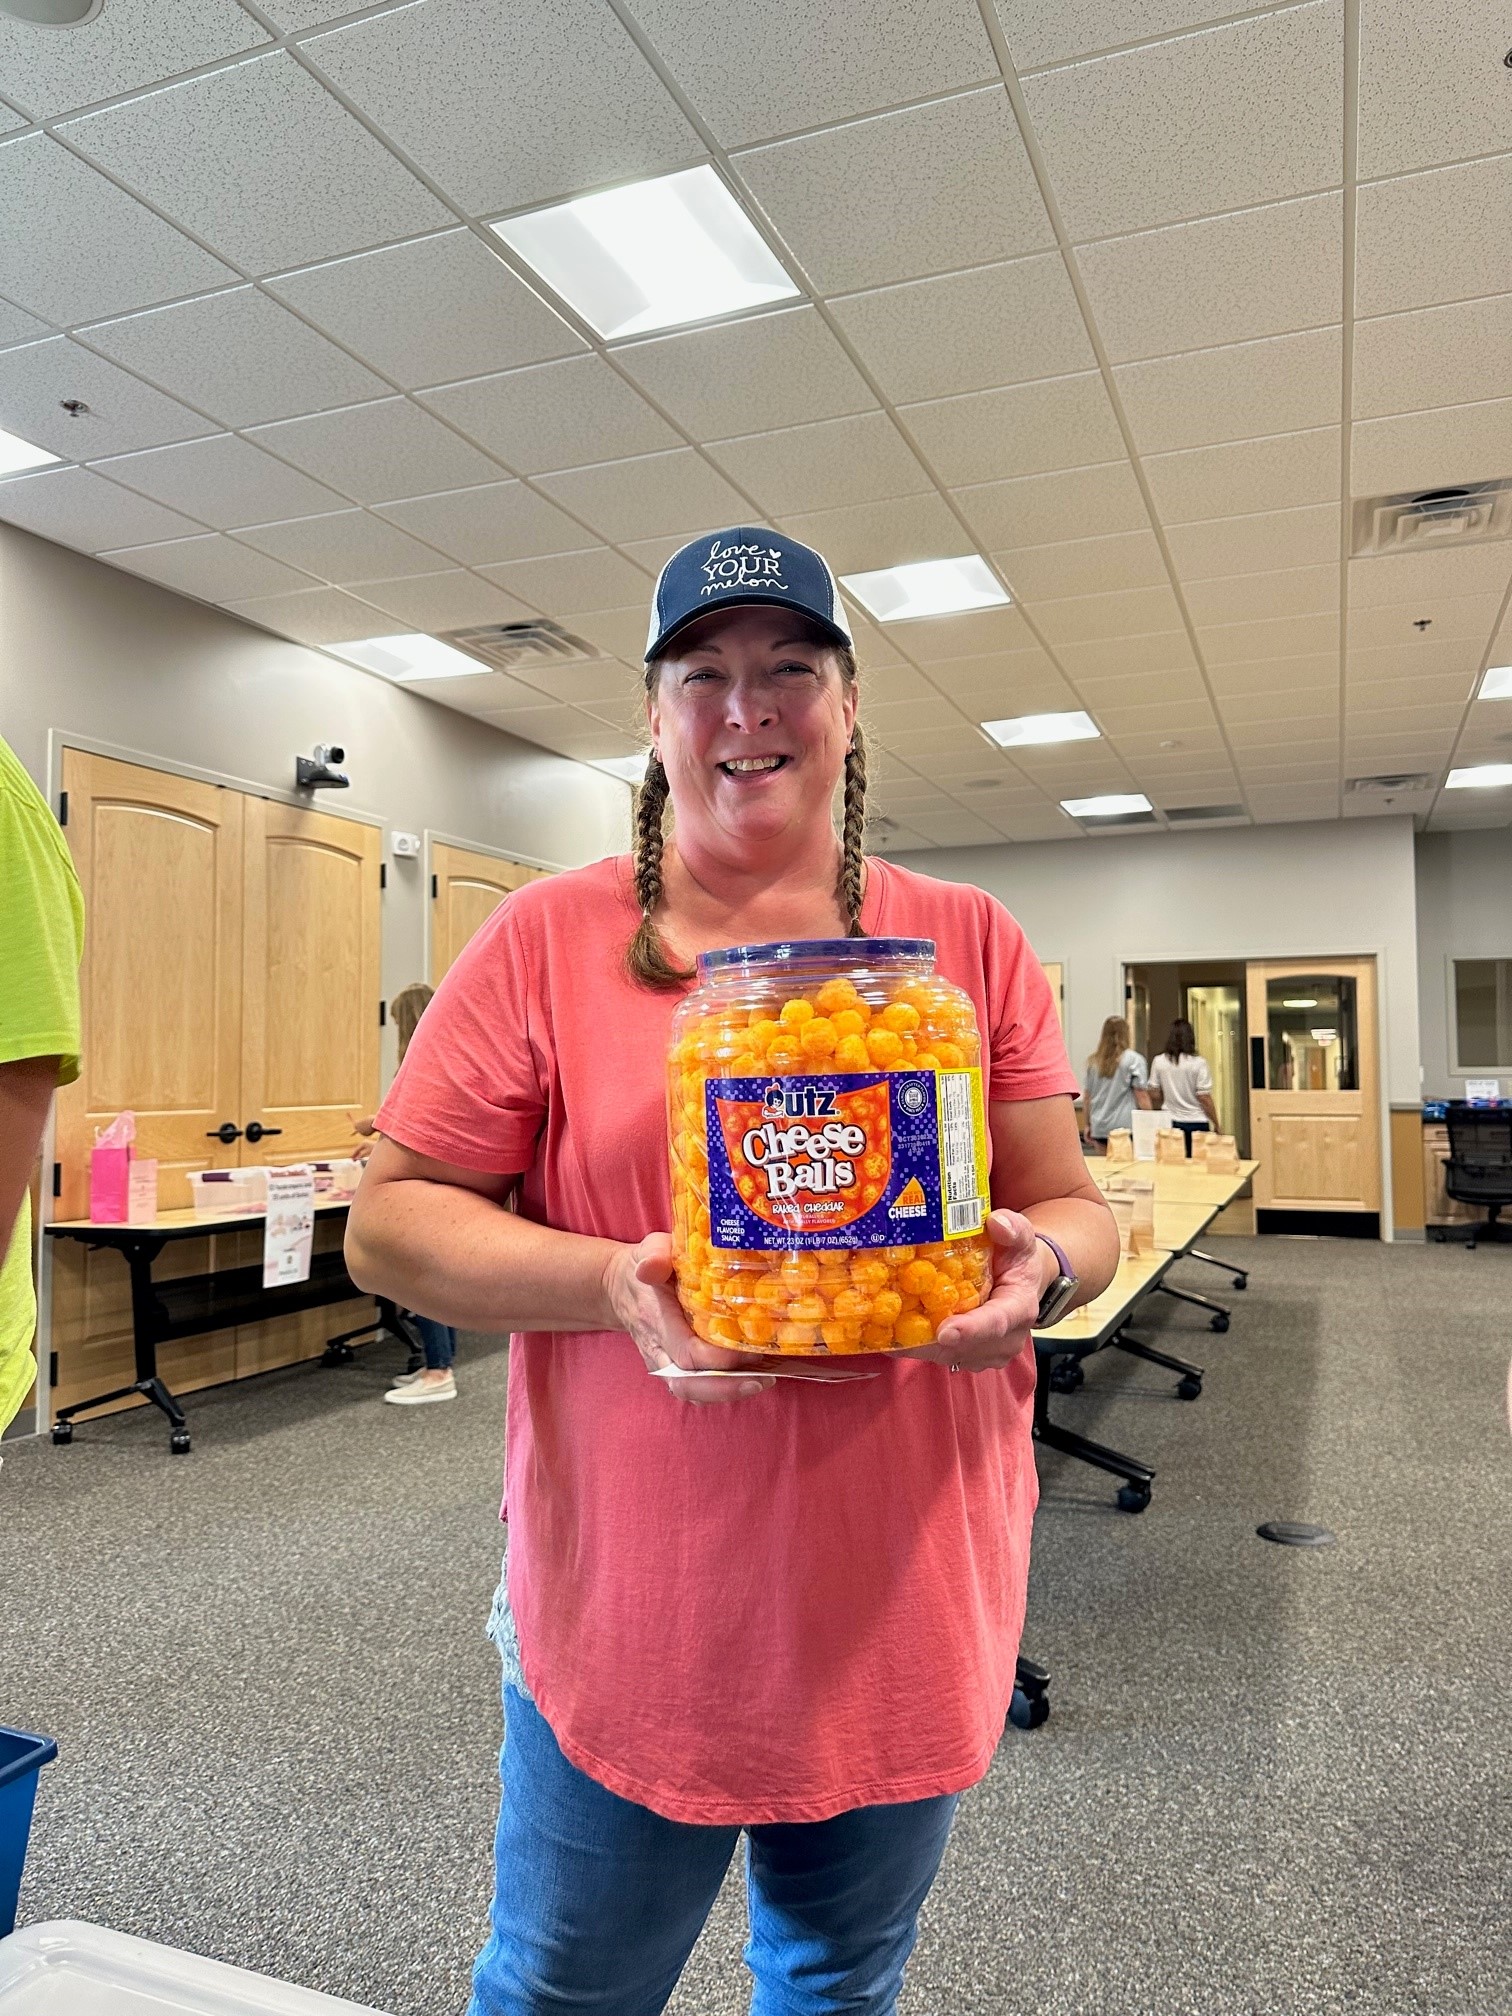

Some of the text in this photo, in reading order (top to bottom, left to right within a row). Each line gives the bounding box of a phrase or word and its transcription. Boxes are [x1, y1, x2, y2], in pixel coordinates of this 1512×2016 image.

[701, 541, 766, 569] love
[701, 568, 788, 596] melon
[703, 556, 782, 582] YOUR
[743, 1121, 866, 1168] Cheese
[764, 1158, 855, 1199] Balls
[888, 1205, 927, 1219] CHEESE
[903, 1194, 924, 1204] REAL
[827, 1236, 837, 1244] OZ)
